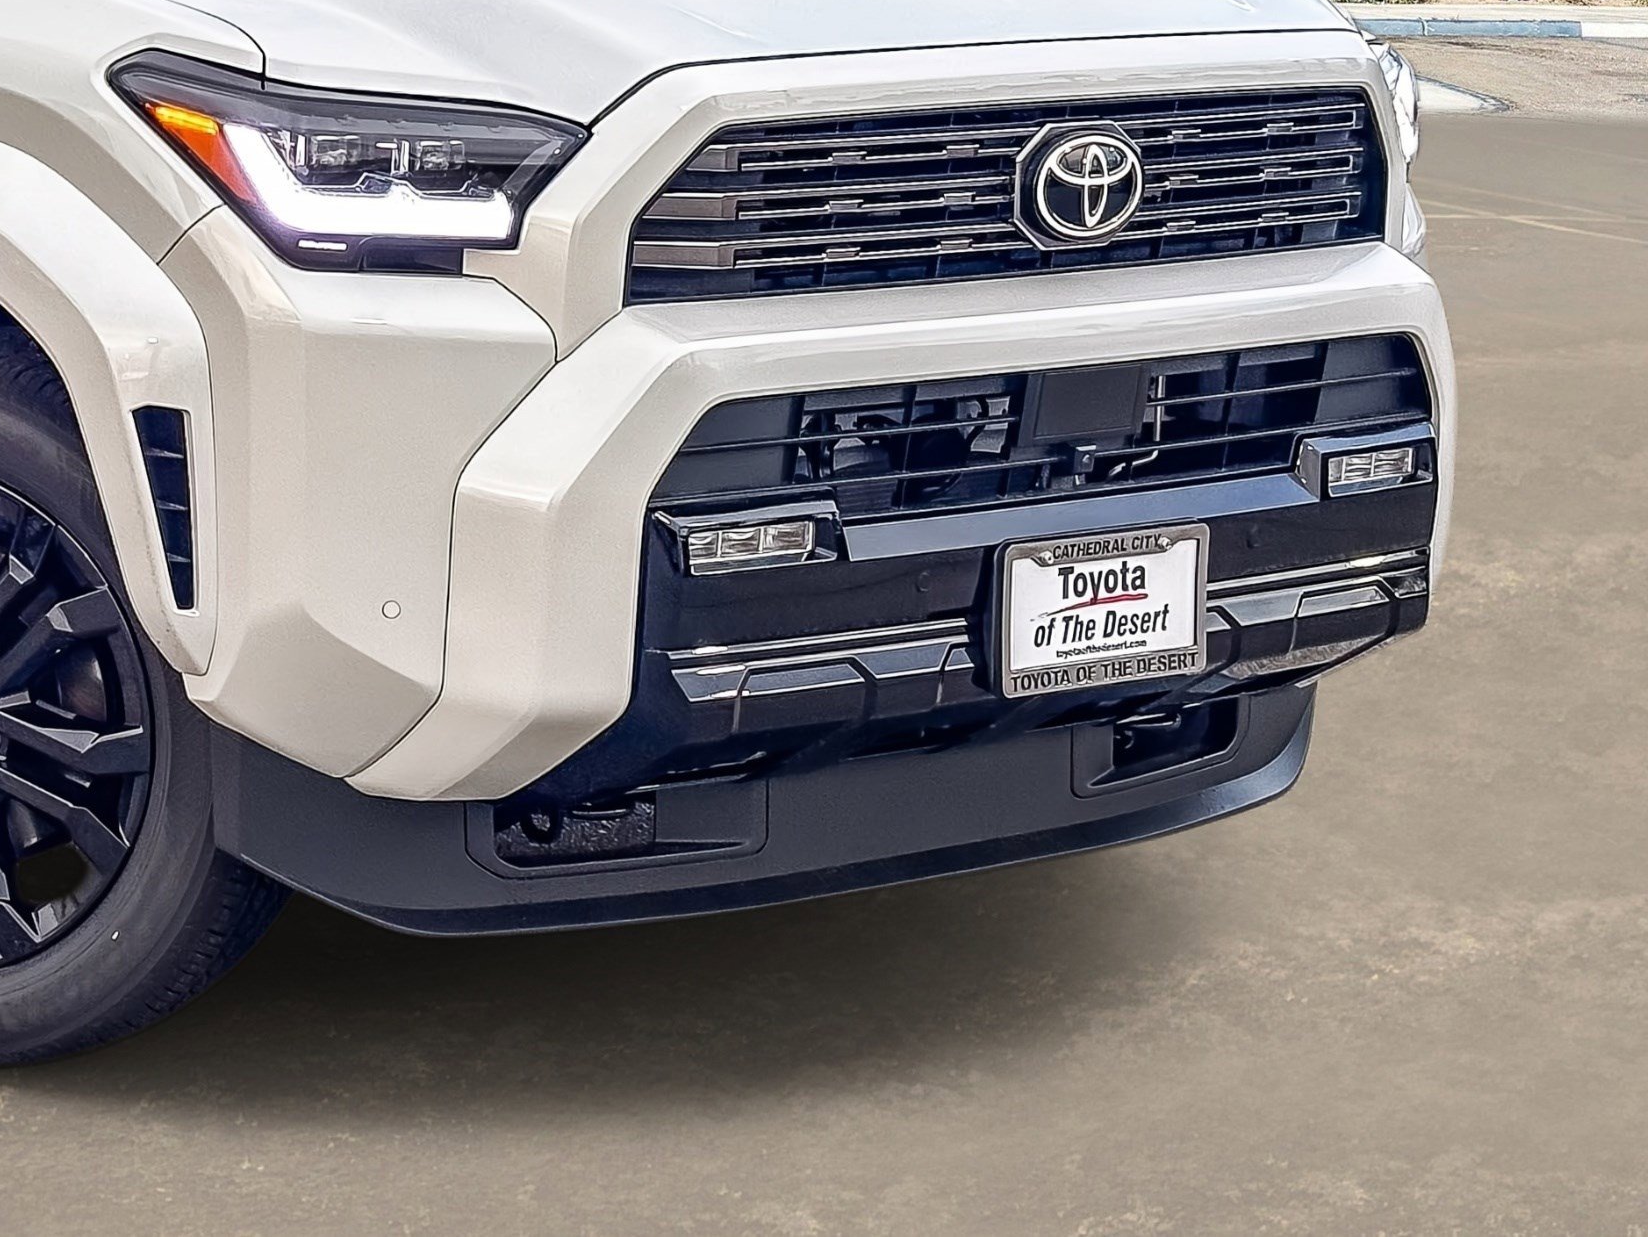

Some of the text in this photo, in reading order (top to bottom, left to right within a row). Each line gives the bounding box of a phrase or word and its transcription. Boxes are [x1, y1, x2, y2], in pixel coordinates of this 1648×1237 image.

[1052, 534, 1162, 560] CATHEDRAL CITY
[1058, 561, 1147, 602] Toyota
[1034, 604, 1170, 647] of The Desert
[1010, 652, 1199, 693] TOYOTA OF THE DESERT
